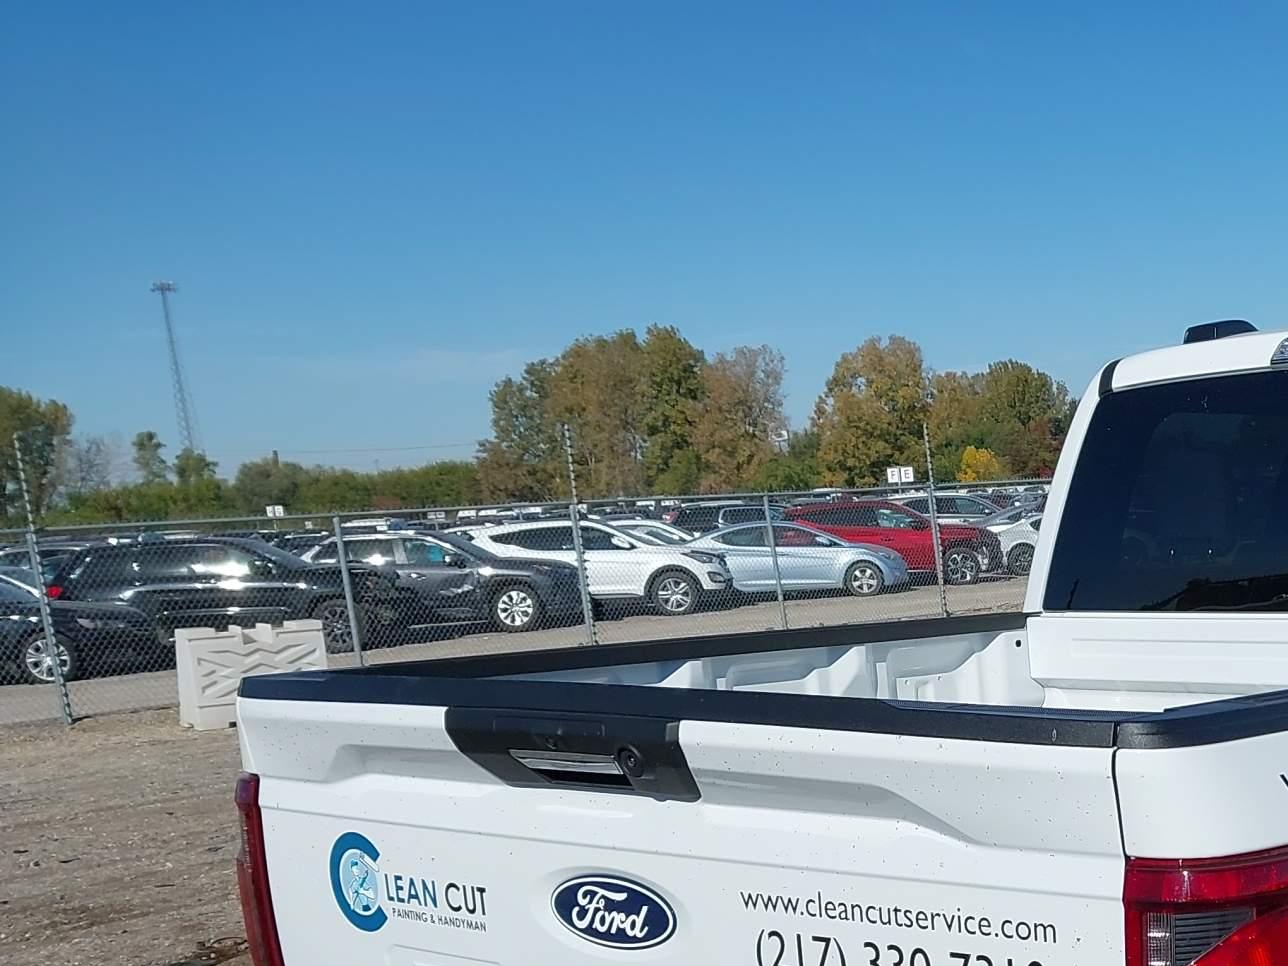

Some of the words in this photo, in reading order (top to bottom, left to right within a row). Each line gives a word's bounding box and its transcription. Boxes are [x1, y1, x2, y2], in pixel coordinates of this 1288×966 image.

[445, 882, 487, 916] CUT
[392, 907, 429, 923] PAINTING
[429, 914, 437, 925] &
[437, 915, 487, 933] HANDYMAN
[740, 891, 1057, 943] www.cleancutservice.com
